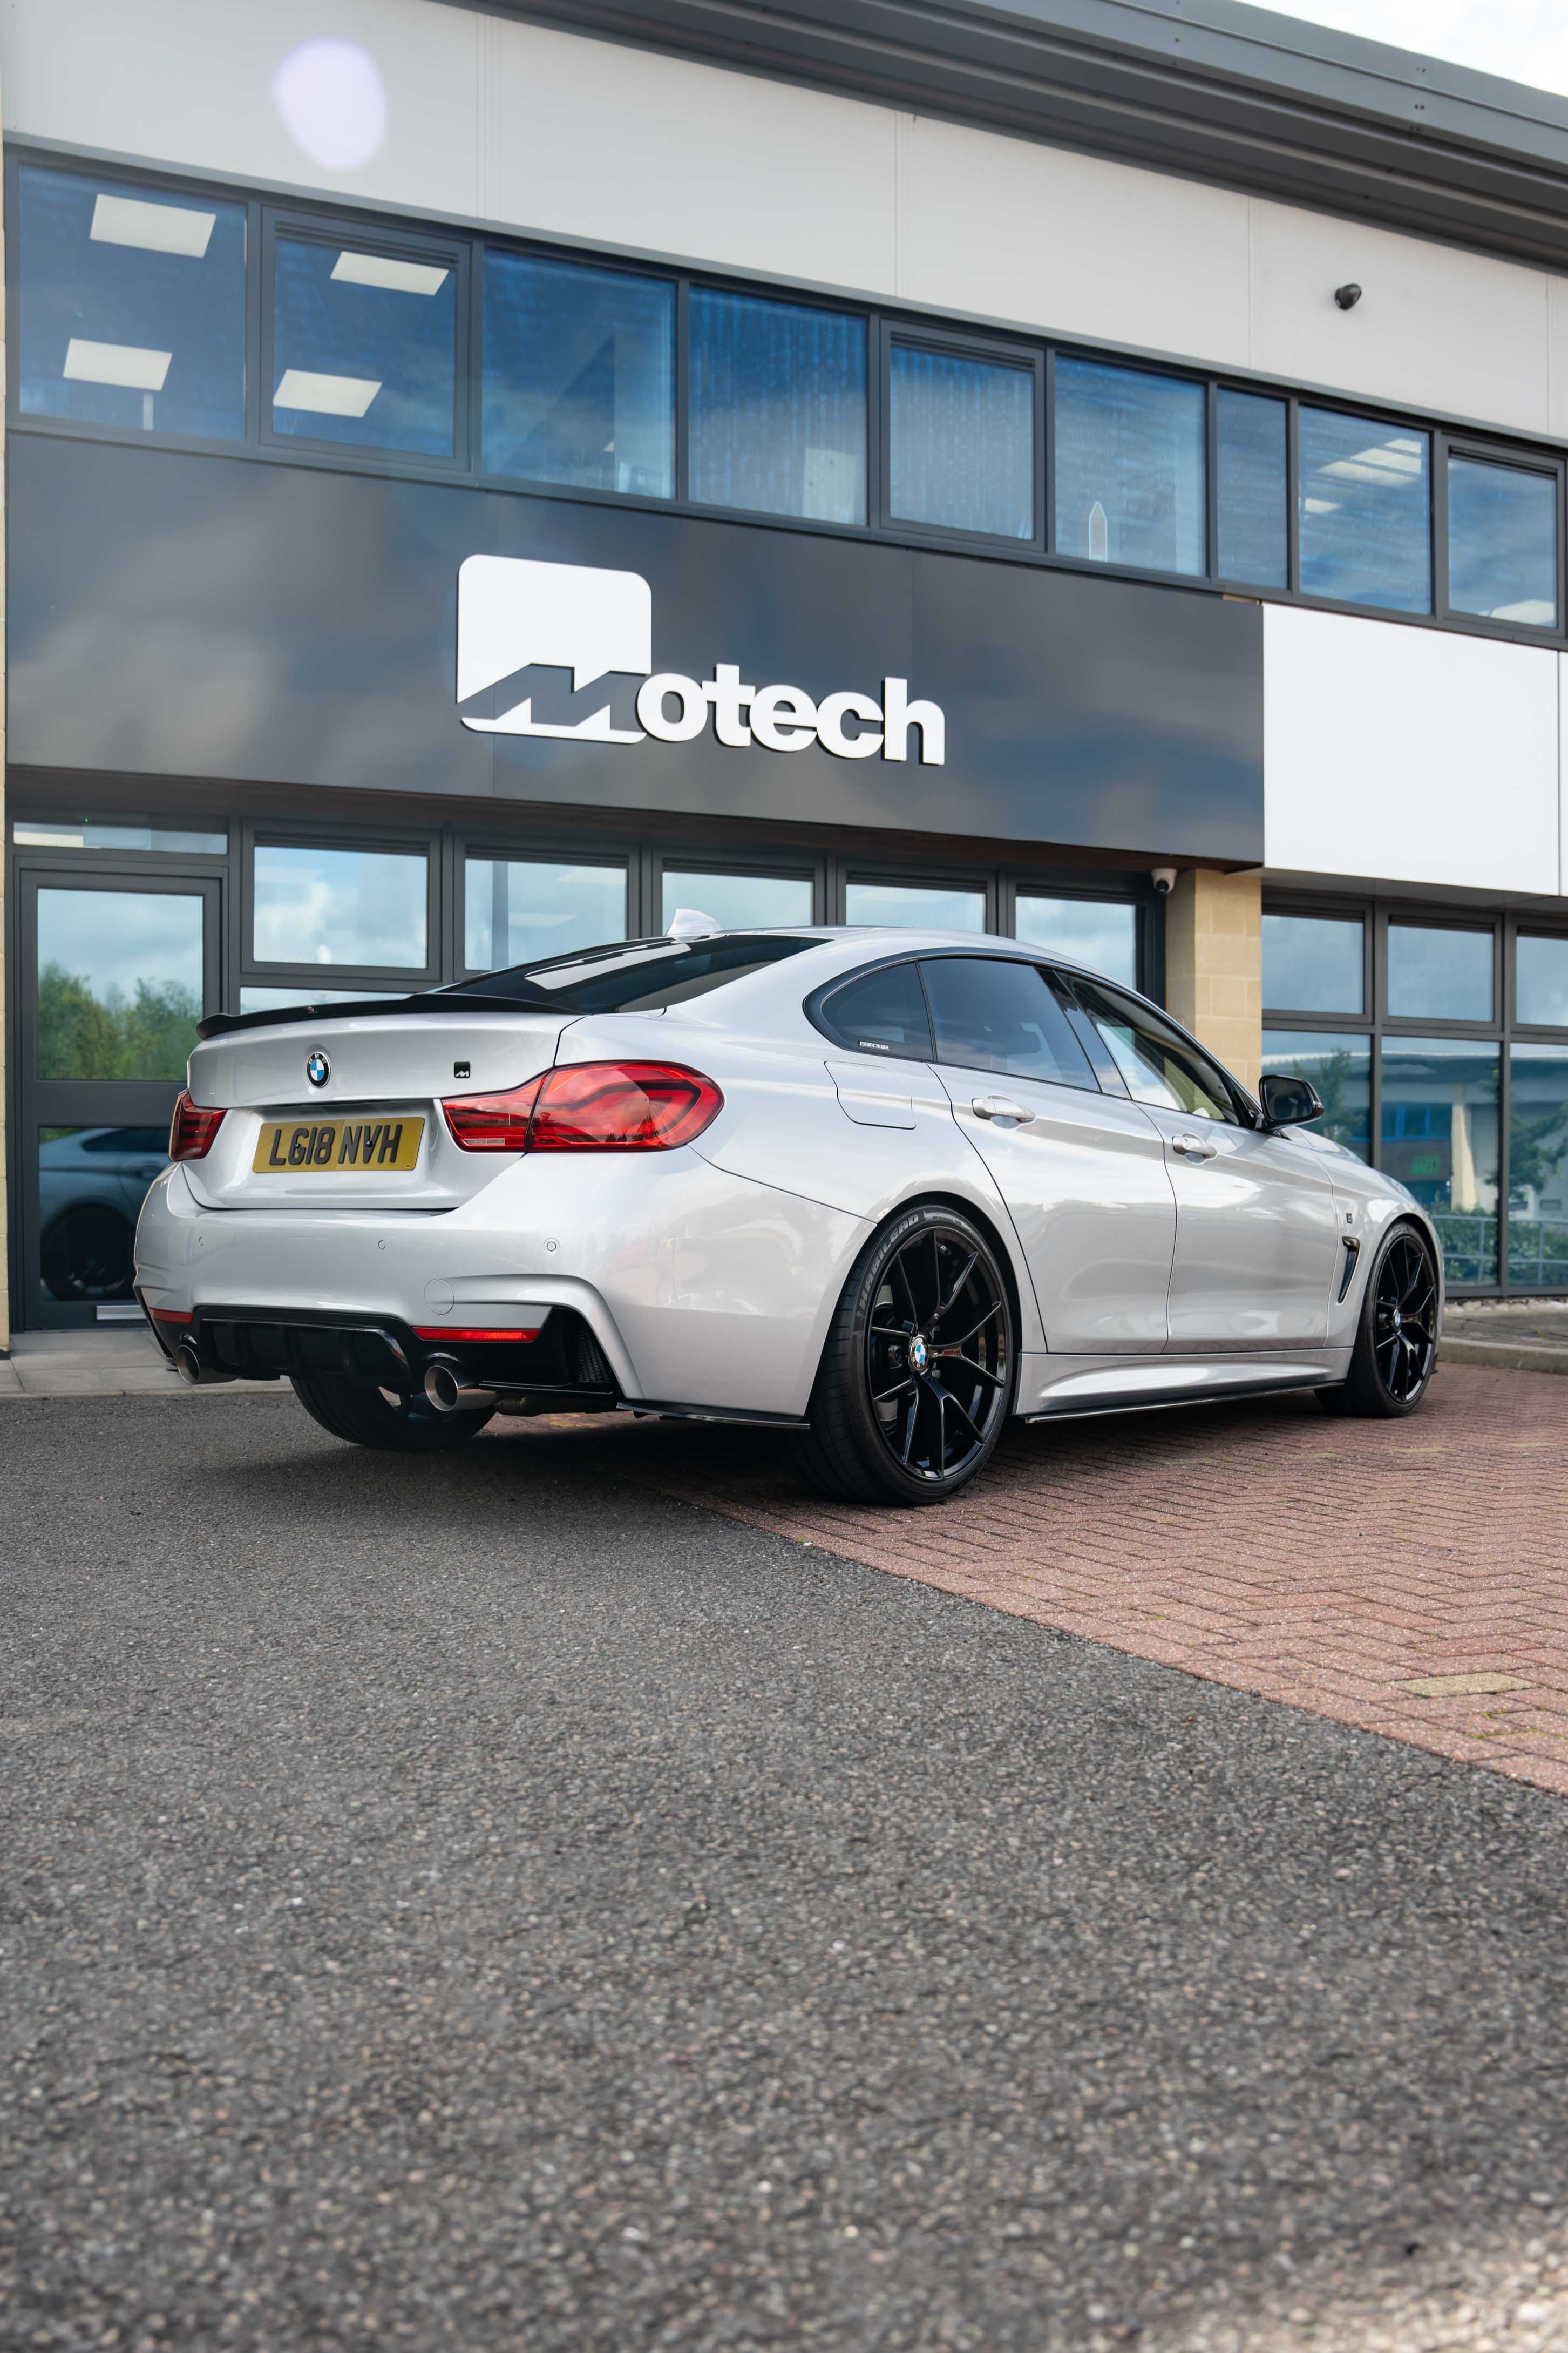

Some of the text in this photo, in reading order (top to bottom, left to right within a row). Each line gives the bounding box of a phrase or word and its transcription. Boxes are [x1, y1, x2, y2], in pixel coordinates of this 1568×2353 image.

[308, 1053, 327, 1064] BMW
[269, 1124, 403, 1165] LG18 NVH
